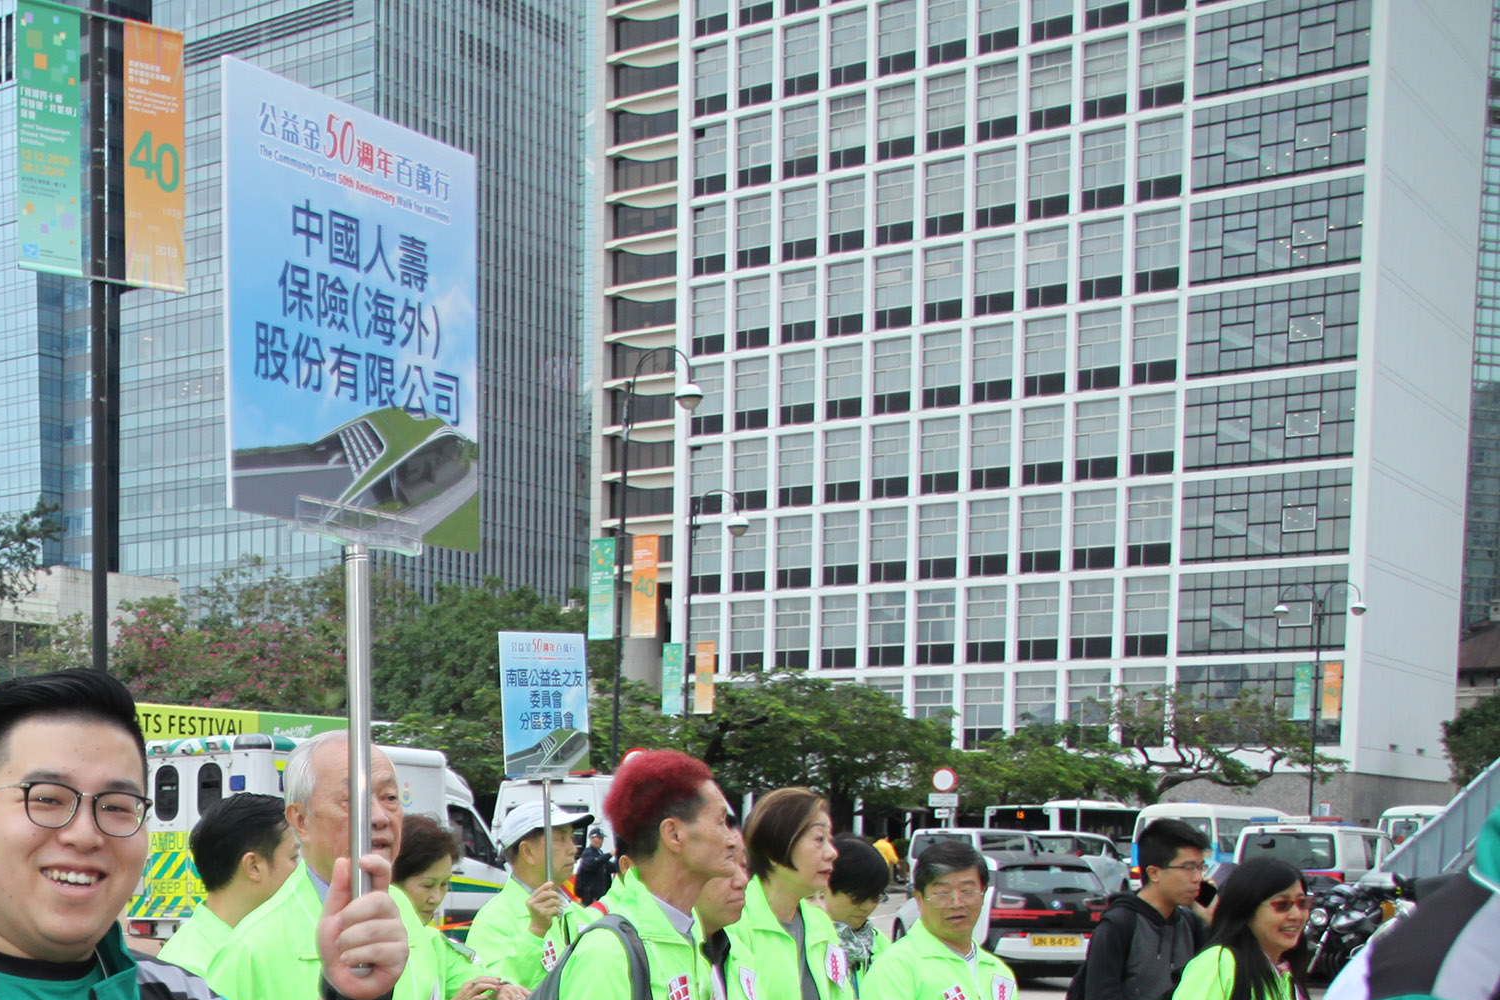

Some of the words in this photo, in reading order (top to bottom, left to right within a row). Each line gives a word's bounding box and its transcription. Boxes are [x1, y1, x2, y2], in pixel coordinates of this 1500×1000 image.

[128, 130, 180, 193] 40
[258, 102, 450, 202] 公益金50週年百萬行
[259, 144, 273, 159] The
[274, 150, 316, 177] Community
[317, 165, 337, 182] Chest
[338, 173, 354, 190] 50th
[355, 181, 396, 207] Anniversary
[396, 195, 413, 211] Walk
[414, 200, 423, 214] for
[424, 205, 450, 224] Millions
[293, 199, 428, 293] 中國人壽
[279, 261, 442, 360] 保險(海外)
[254, 322, 461, 427] 股份有限公司
[634, 576, 655, 598] 40
[506, 668, 583, 687] 南區公益金之友
[519, 711, 574, 730] 分區委員會
[530, 690, 562, 709] 委員會
[152, 881, 181, 894] KEEP
[186, 881, 208, 894] CLE
[1033, 937, 1047, 947] UN
[1050, 937, 1076, 947] 8475
